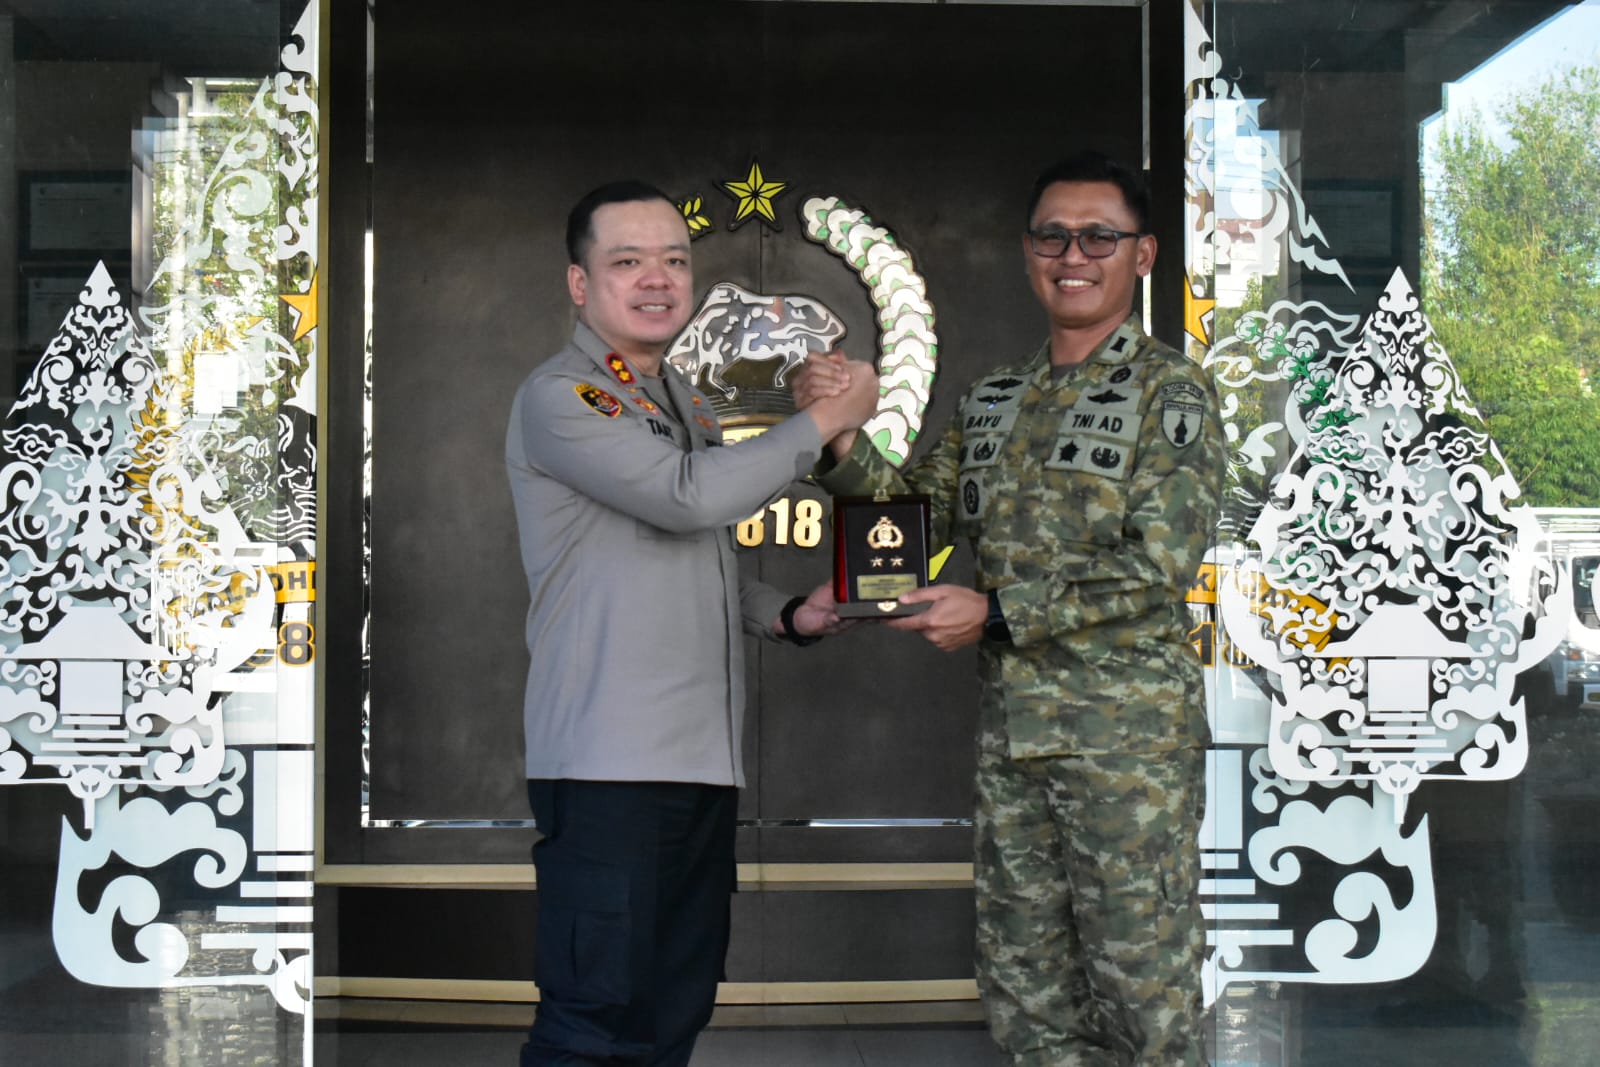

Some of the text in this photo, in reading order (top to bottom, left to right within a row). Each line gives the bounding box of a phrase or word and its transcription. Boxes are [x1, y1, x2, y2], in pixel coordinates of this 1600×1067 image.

[966, 415, 1002, 429] BAYU
[1072, 414, 1123, 434] TNI AD
